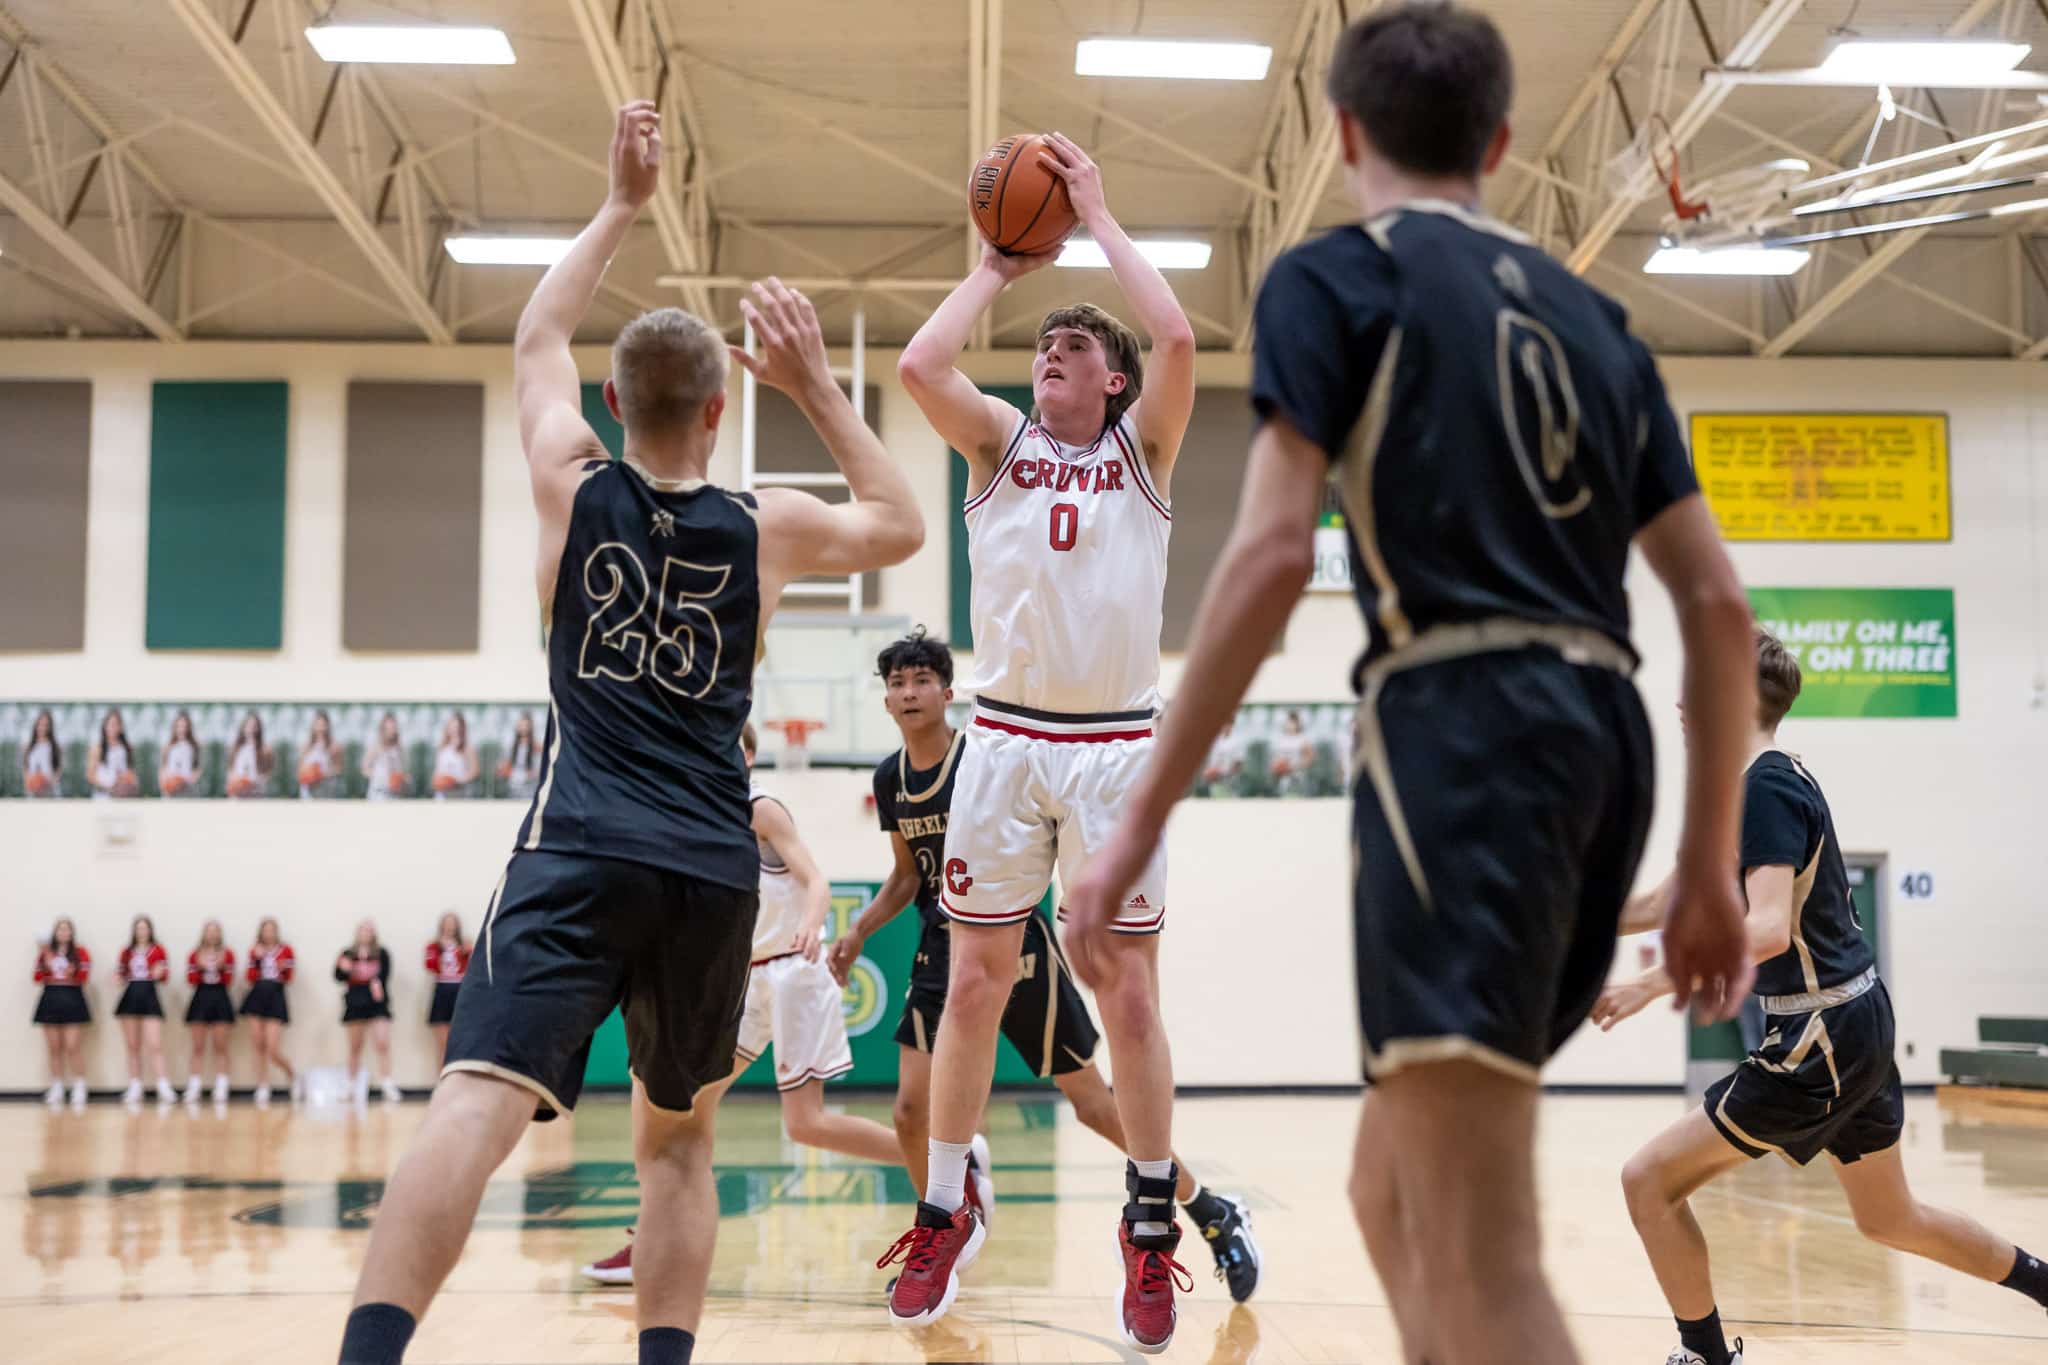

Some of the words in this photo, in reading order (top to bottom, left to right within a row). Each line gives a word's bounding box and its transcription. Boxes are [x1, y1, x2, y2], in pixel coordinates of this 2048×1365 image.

[976, 165, 1001, 211] ROCK
[1049, 502, 1079, 551] 0
[577, 542, 732, 699] 25
[1855, 620, 1897, 643] ON
[1808, 646, 1854, 672] ON
[1862, 646, 1950, 672] THREE
[898, 811, 949, 840] WHEEL
[1900, 873, 1933, 899] 40
